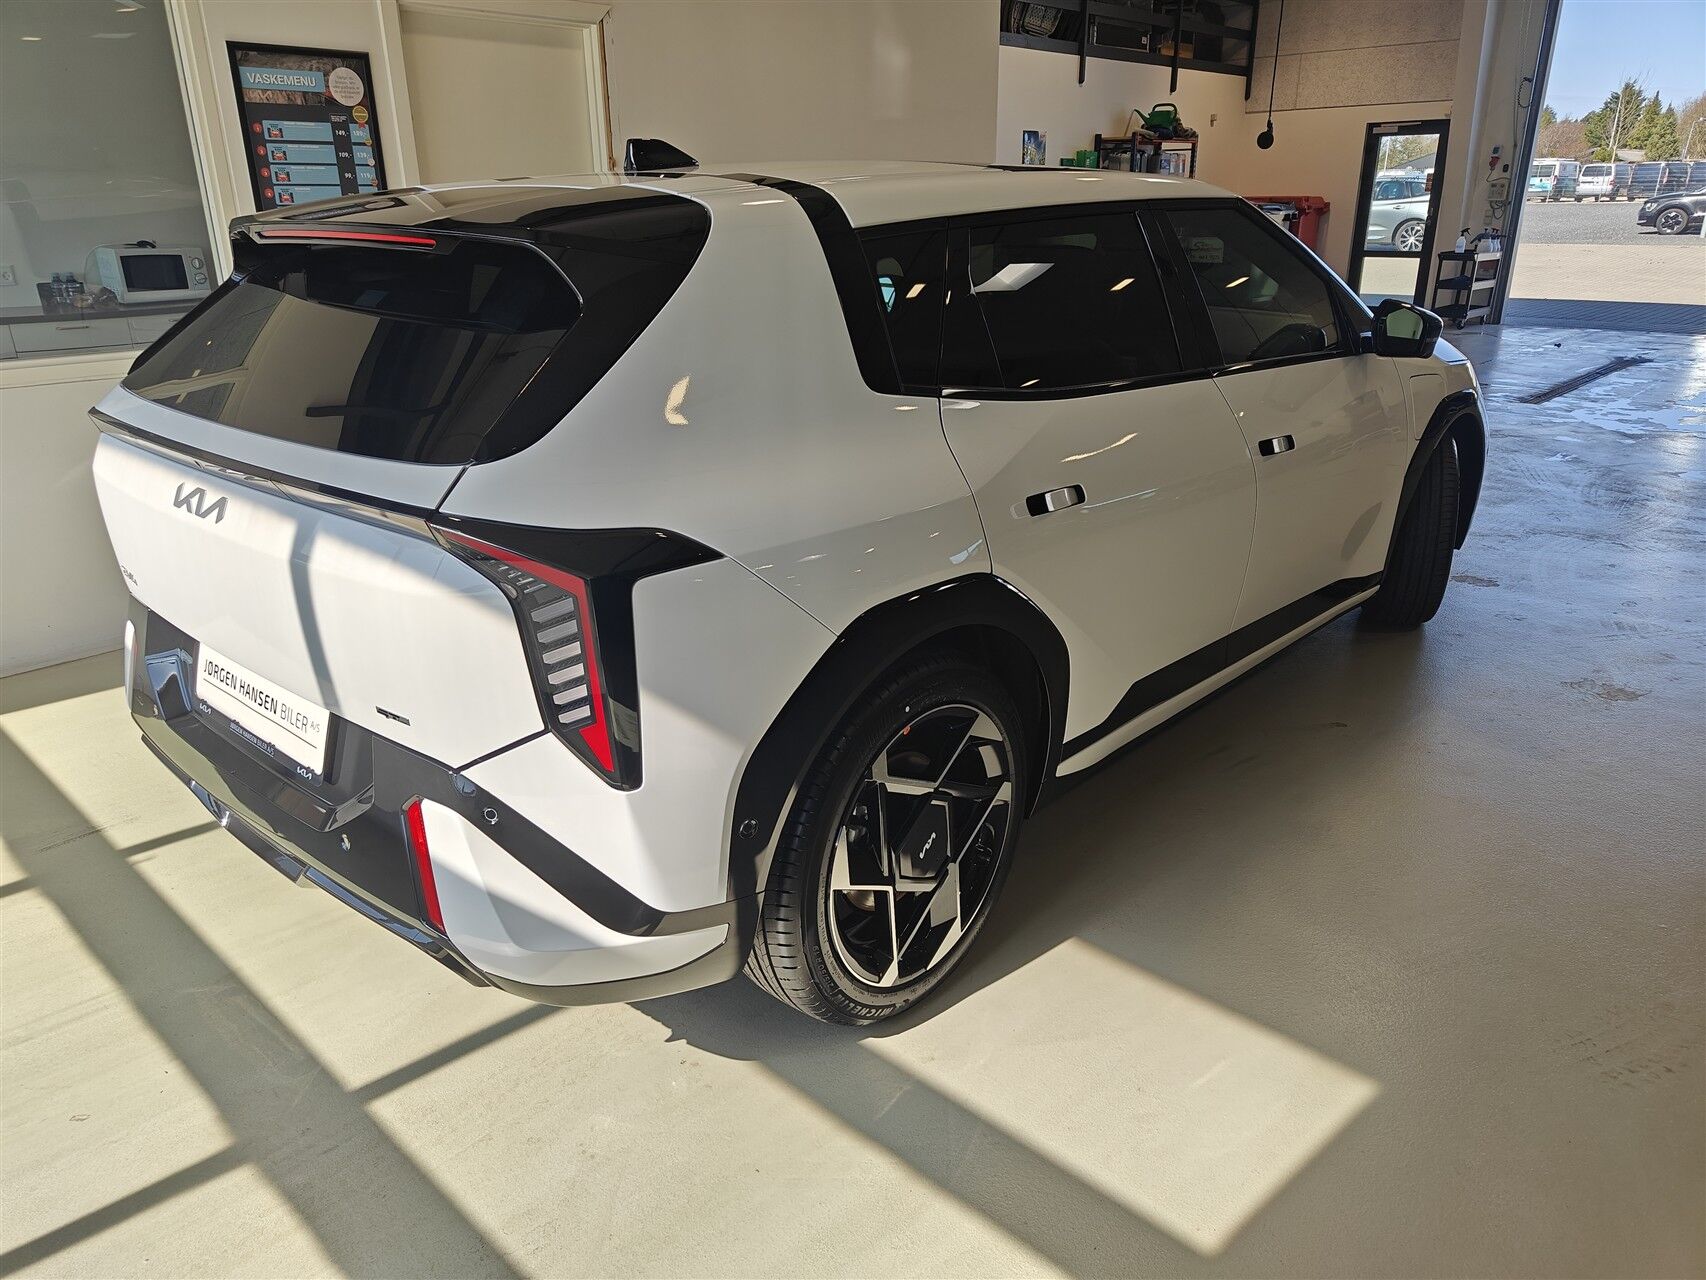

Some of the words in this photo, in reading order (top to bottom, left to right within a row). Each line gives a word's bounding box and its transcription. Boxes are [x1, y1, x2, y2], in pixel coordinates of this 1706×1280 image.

[247, 72, 317, 87] VASKEMENU
[173, 482, 229, 524] KIA
[203, 659, 237, 691] JØRGEN
[239, 678, 278, 715] HANSEN
[280, 702, 309, 734] BILER
[310, 721, 321, 733] A/S
[199, 702, 212, 715] KIA
[296, 766, 312, 780] KIA
[835, 992, 894, 1017] MICHELIN
